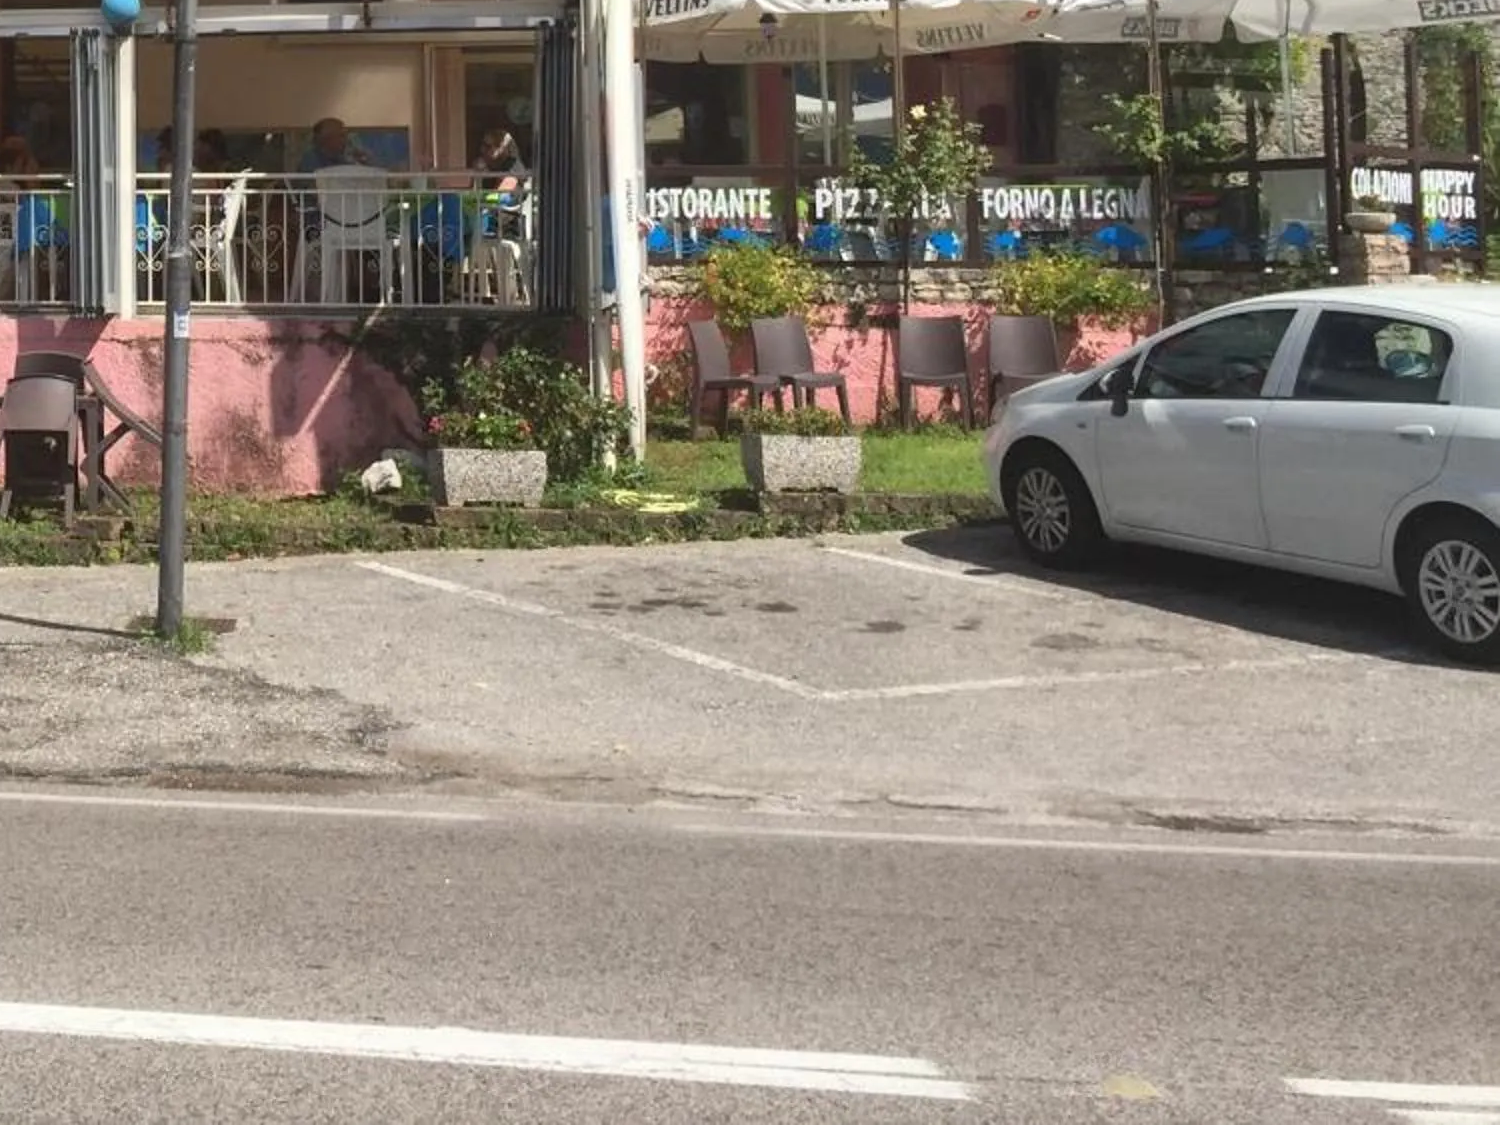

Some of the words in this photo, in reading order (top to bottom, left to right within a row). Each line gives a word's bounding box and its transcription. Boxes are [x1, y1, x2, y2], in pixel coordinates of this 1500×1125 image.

[1420, 168, 1476, 194] HAPPY
[646, 187, 772, 219] ISTORANTE
[982, 187, 1055, 219] FORNO
[1060, 187, 1075, 219] A
[1079, 186, 1150, 219] LEGNA
[1422, 195, 1477, 219] HOUR
